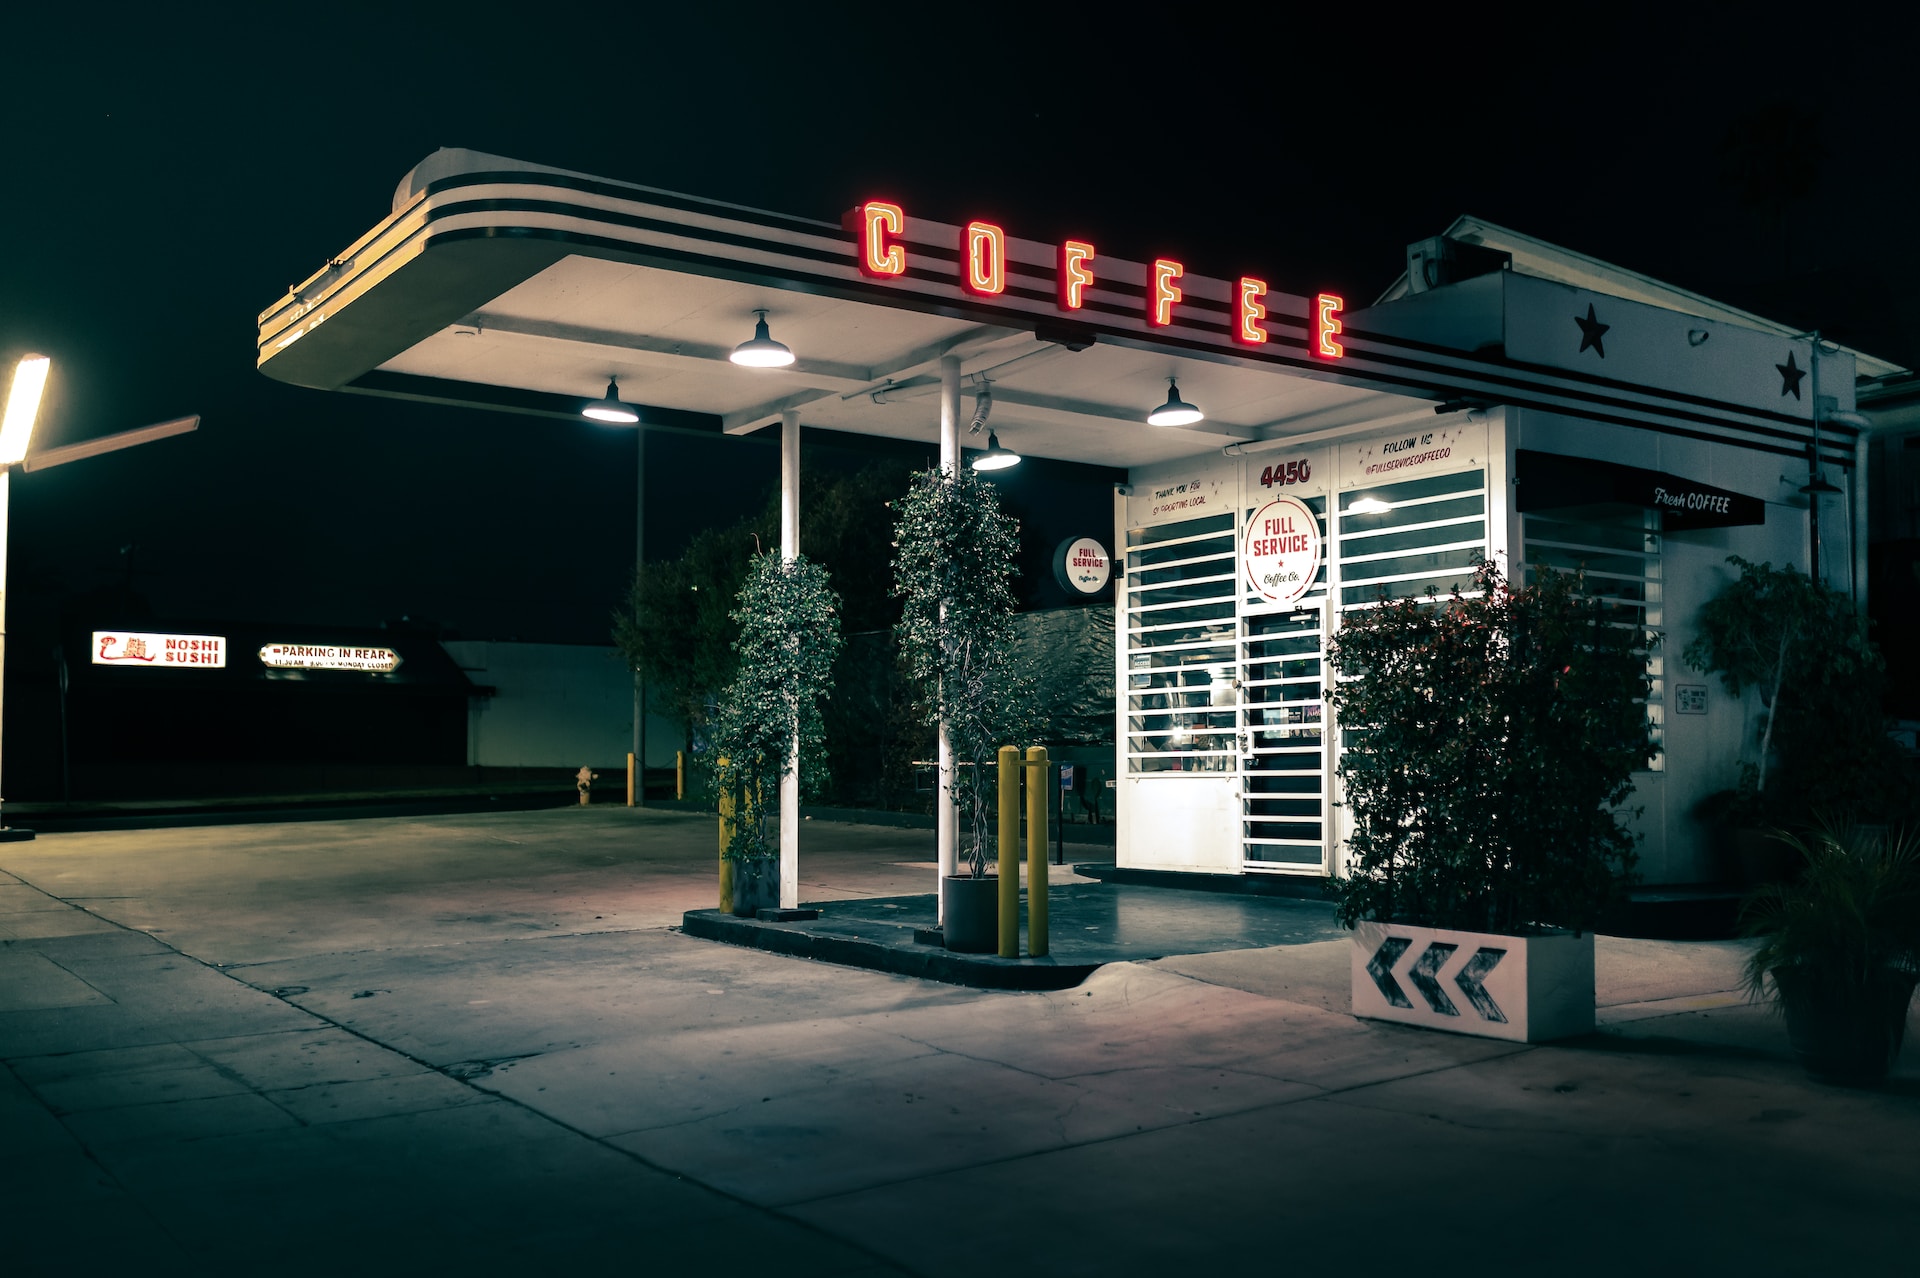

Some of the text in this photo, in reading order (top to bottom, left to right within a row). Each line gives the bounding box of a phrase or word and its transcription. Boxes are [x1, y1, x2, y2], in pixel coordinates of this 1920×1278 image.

[861, 201, 1344, 359] COFFEE
[1383, 437, 1417, 455] FOLLOW
[1365, 447, 1451, 475] @FULLSERVICECOFFEECO
[1260, 458, 1312, 489] 4450
[1155, 480, 1201, 500] THANK YOU FOR
[1189, 496, 1206, 507] LOCAL
[1654, 487, 1731, 514] Fresh COFFEE
[1265, 516, 1295, 536] FULL
[1079, 548, 1096, 558] FULL
[1253, 534, 1308, 557] SERVICE
[1072, 557, 1103, 568] SERVICE
[1263, 571, 1300, 587] Coffee Co.
[165, 639, 219, 651] NOSHI
[282, 646, 386, 660] PARKING IN REAR
[165, 652, 219, 664] SUSHI
